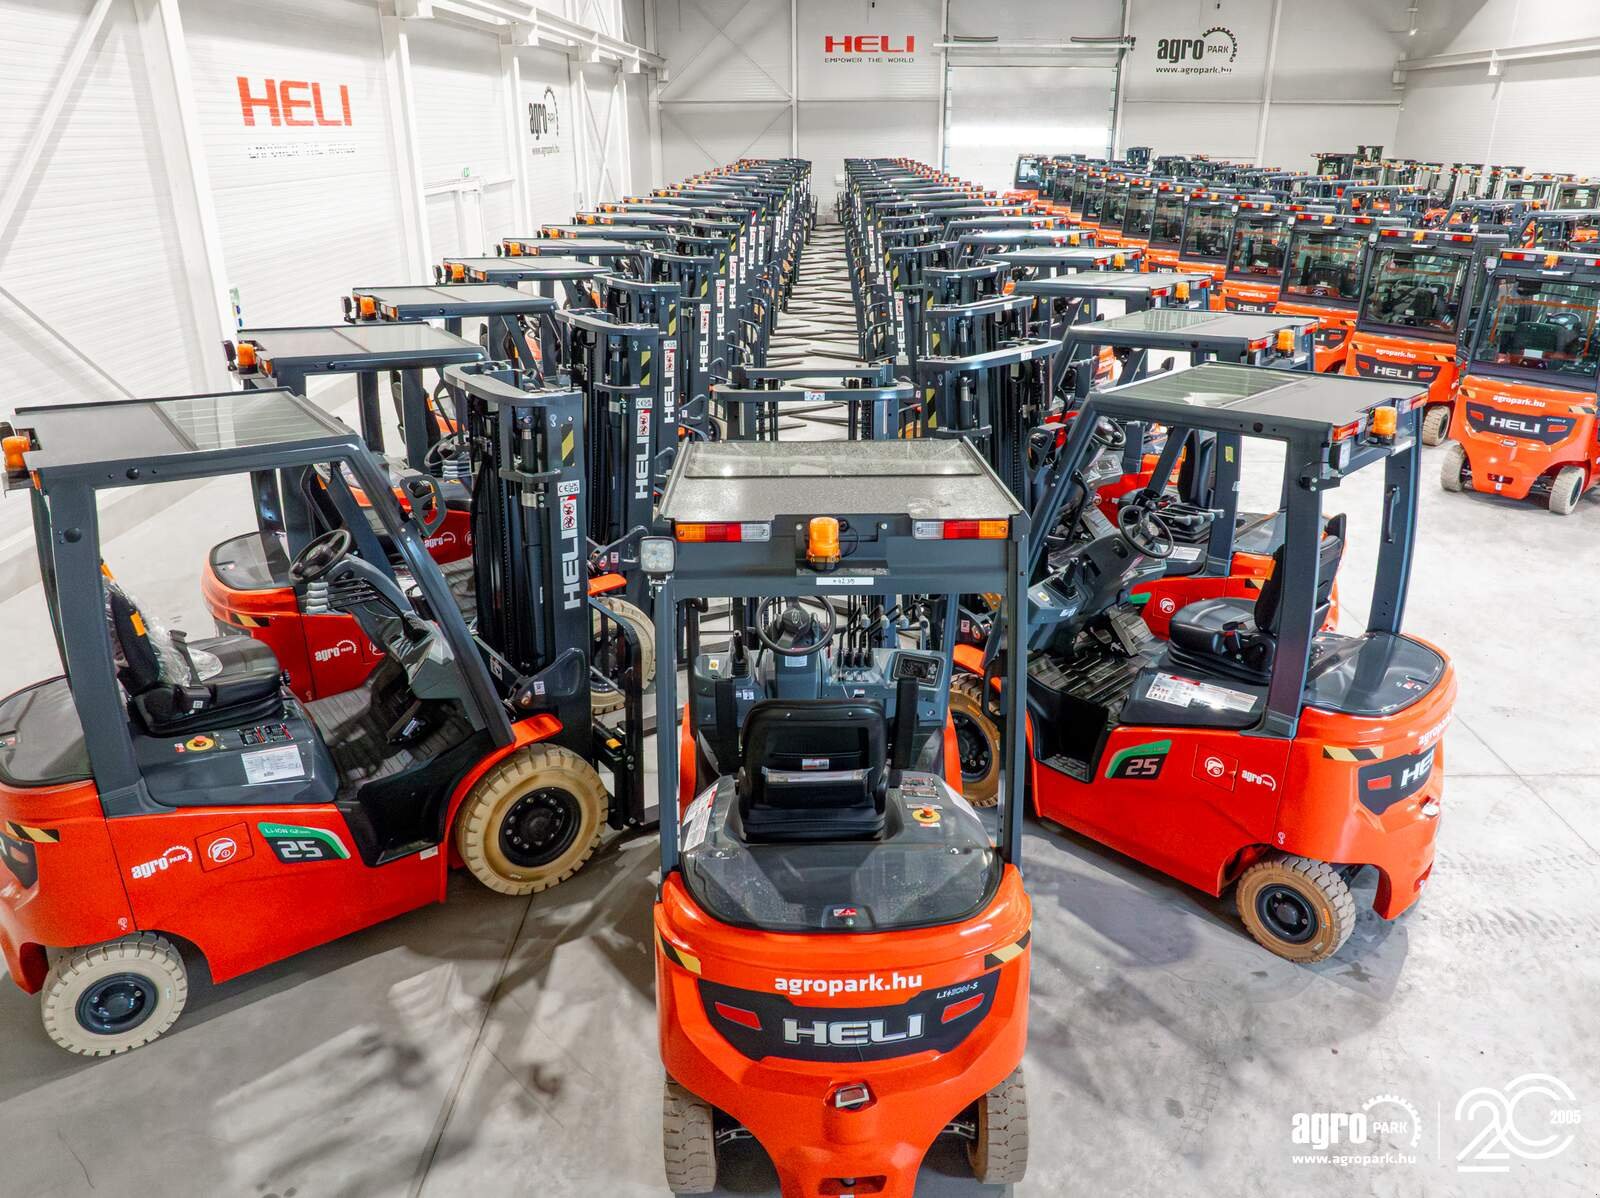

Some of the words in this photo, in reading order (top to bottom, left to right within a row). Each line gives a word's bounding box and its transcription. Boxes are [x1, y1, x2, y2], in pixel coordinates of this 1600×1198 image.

[825, 35, 914, 53] HELI
[1157, 38, 1204, 63] agro
[1207, 45, 1229, 53] PARK
[237, 76, 352, 126] HELI
[529, 102, 548, 140] agro
[1238, 304, 1266, 313] HELI
[716, 303, 725, 341] HELI
[896, 316, 905, 356] HELI
[700, 328, 709, 372] HELI
[1376, 348, 1416, 359] agropark.hu
[1374, 365, 1413, 379] HELI
[664, 372, 675, 424] HELI
[1493, 394, 1546, 408] agropark.hu
[1490, 416, 1541, 434] HELI
[635, 436, 650, 500] HELI
[561, 528, 581, 611] HELI
[314, 646, 340, 661] agro
[1125, 758, 1161, 776] 25
[1241, 770, 1263, 785] agro
[277, 841, 323, 858] 25
[131, 856, 168, 879] agro
[168, 854, 187, 864] PARK
[774, 971, 923, 997] agropark.hu
[783, 1013, 925, 1047] HELI
